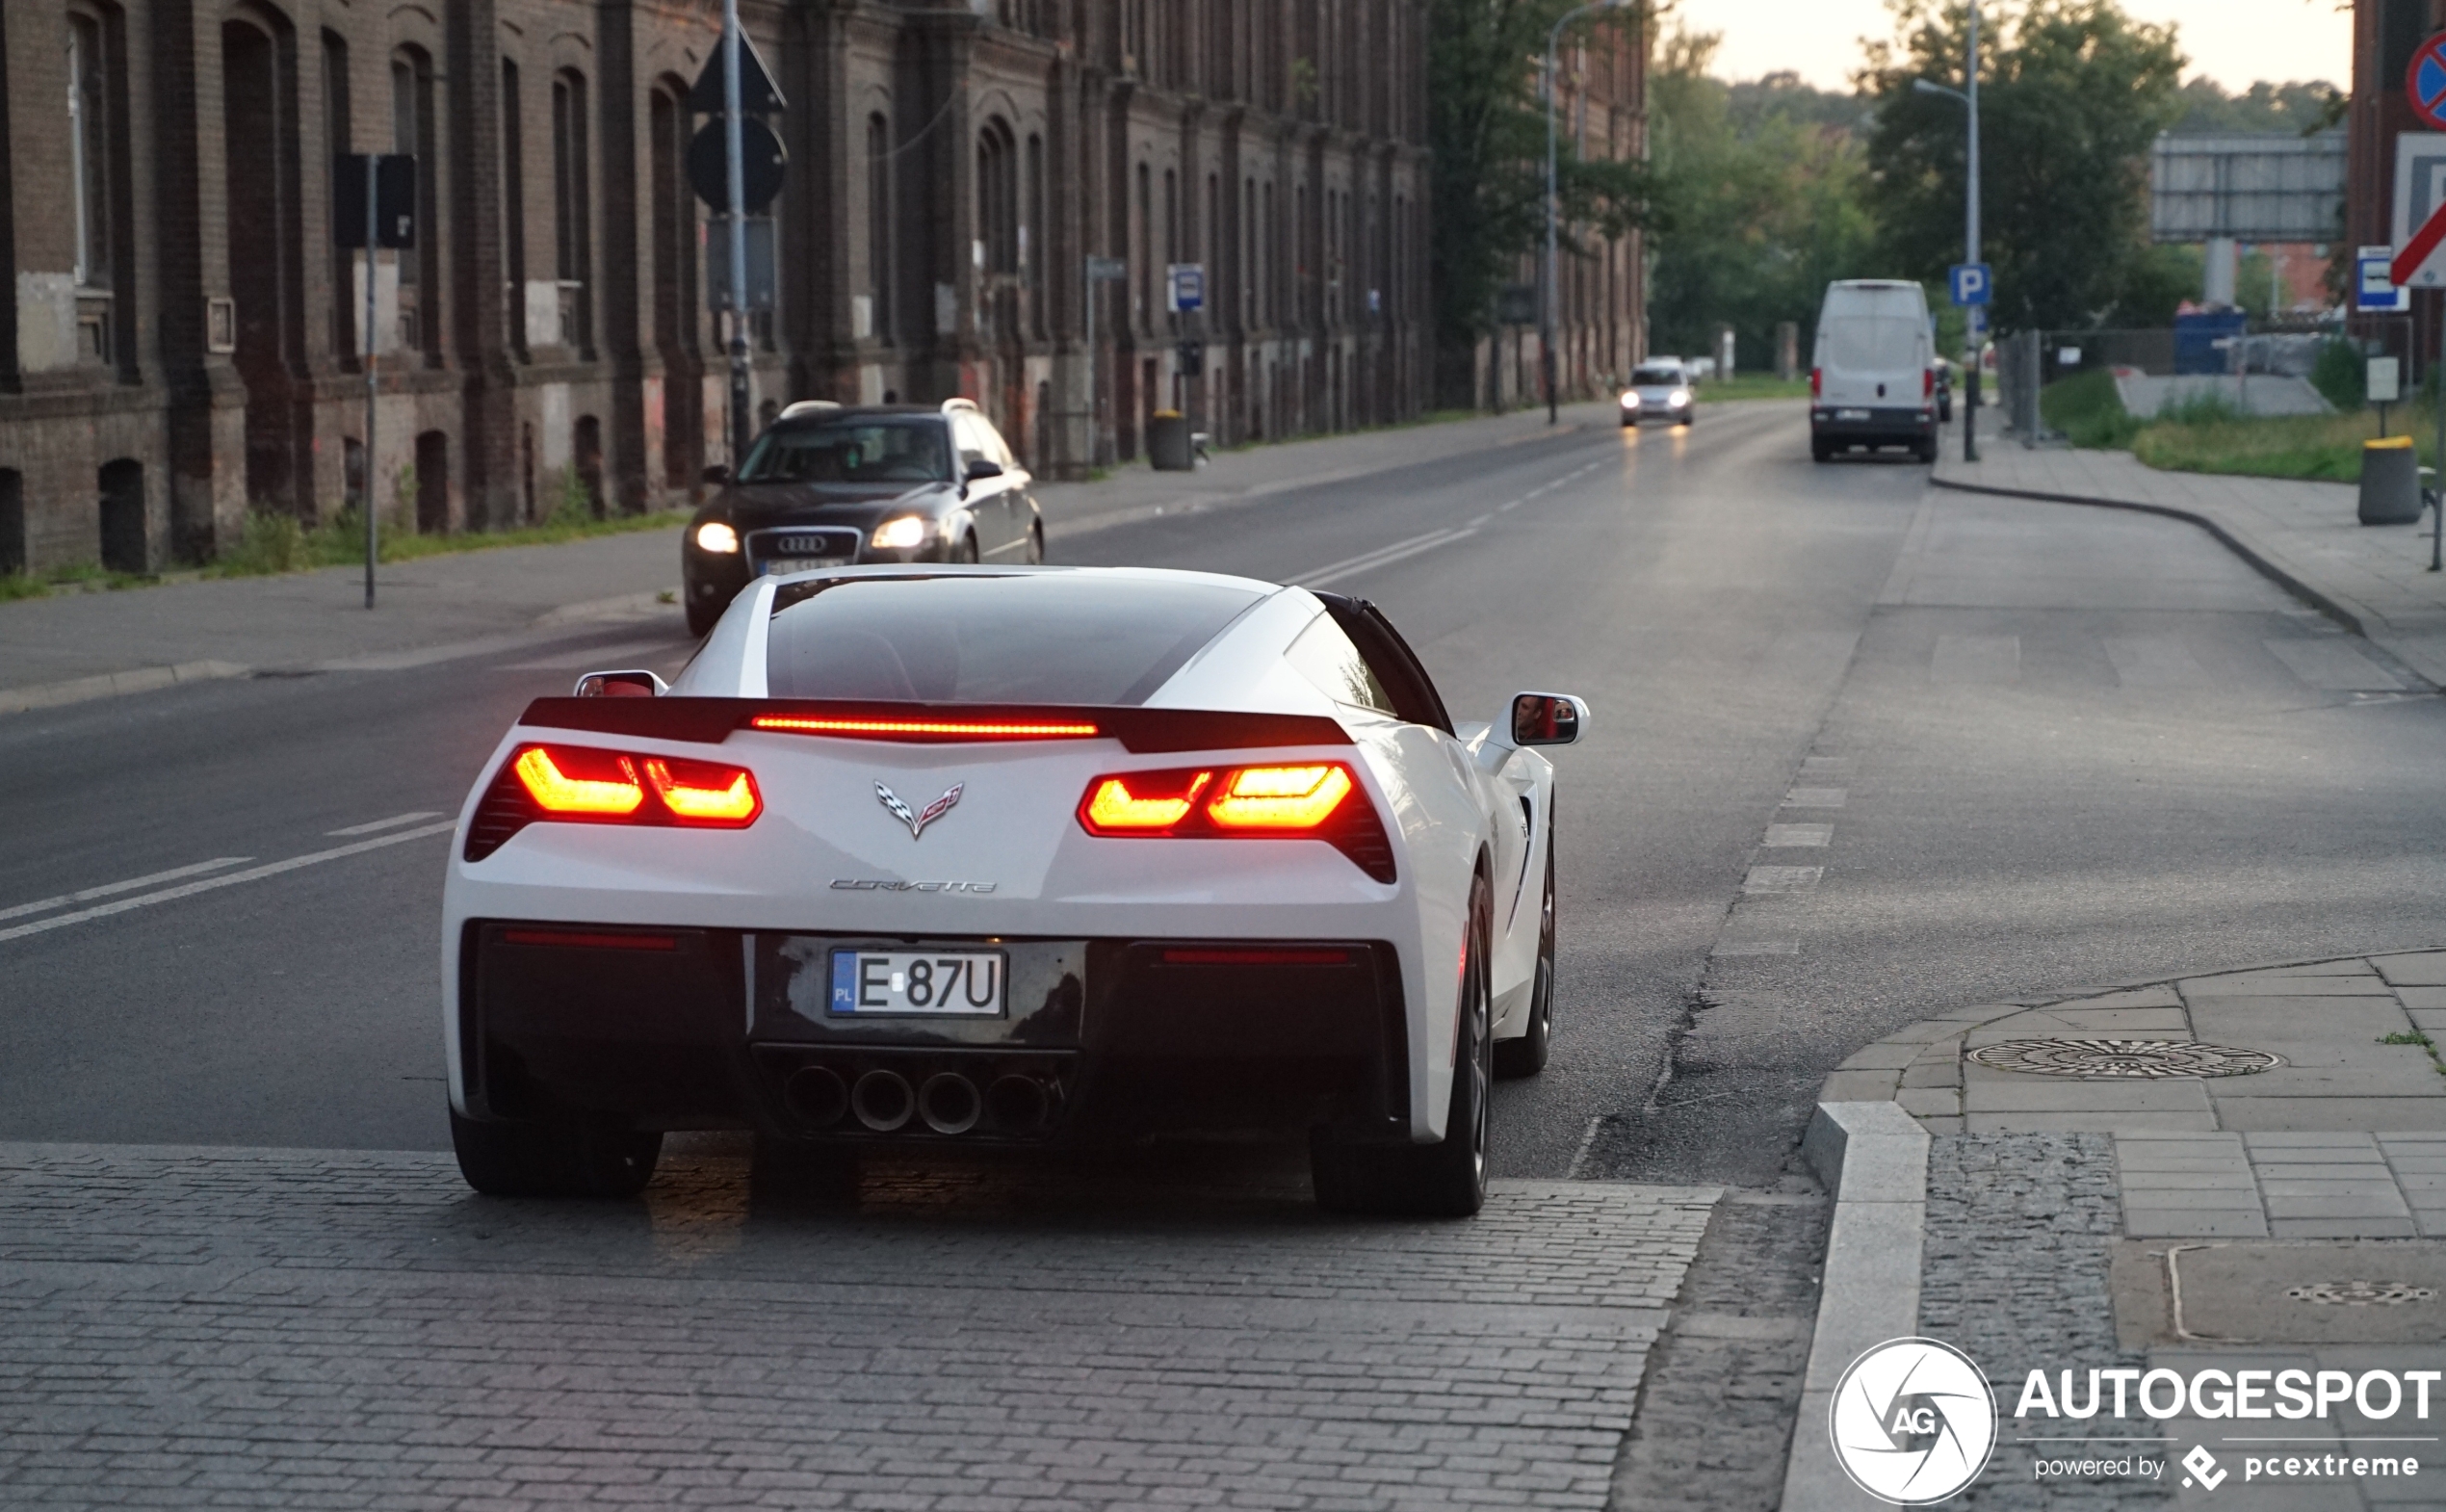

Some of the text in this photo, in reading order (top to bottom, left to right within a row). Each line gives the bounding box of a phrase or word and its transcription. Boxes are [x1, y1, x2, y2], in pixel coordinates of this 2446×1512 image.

[1959, 269, 1983, 301] P
[829, 878, 997, 894] CORVETTE
[835, 988, 852, 1003] PL
